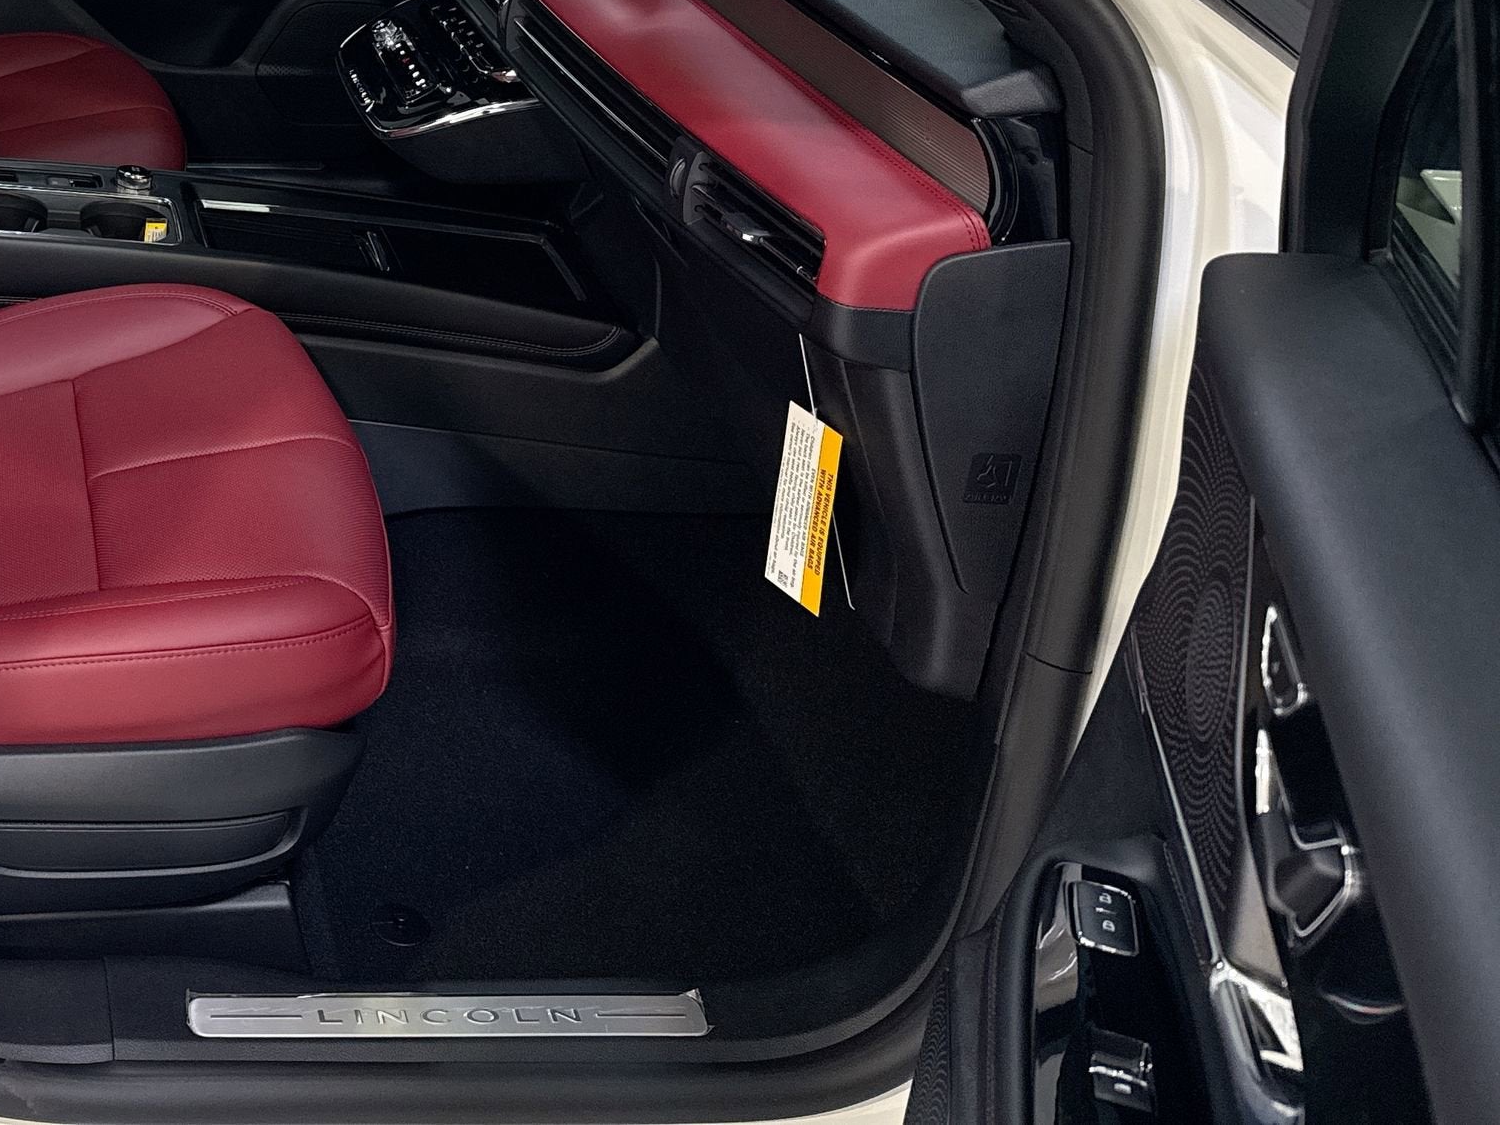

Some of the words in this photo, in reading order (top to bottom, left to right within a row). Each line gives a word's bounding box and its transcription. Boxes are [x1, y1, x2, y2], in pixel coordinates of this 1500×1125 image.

[818, 468, 826, 490] WITH
[812, 491, 823, 533] ADVANCED
[821, 492, 830, 526] VEHICLE
[820, 528, 825, 536] IS
[807, 549, 815, 569] BAGS
[814, 537, 824, 576] EQUIPPED
[317, 1008, 583, 1025] LINCOLN
